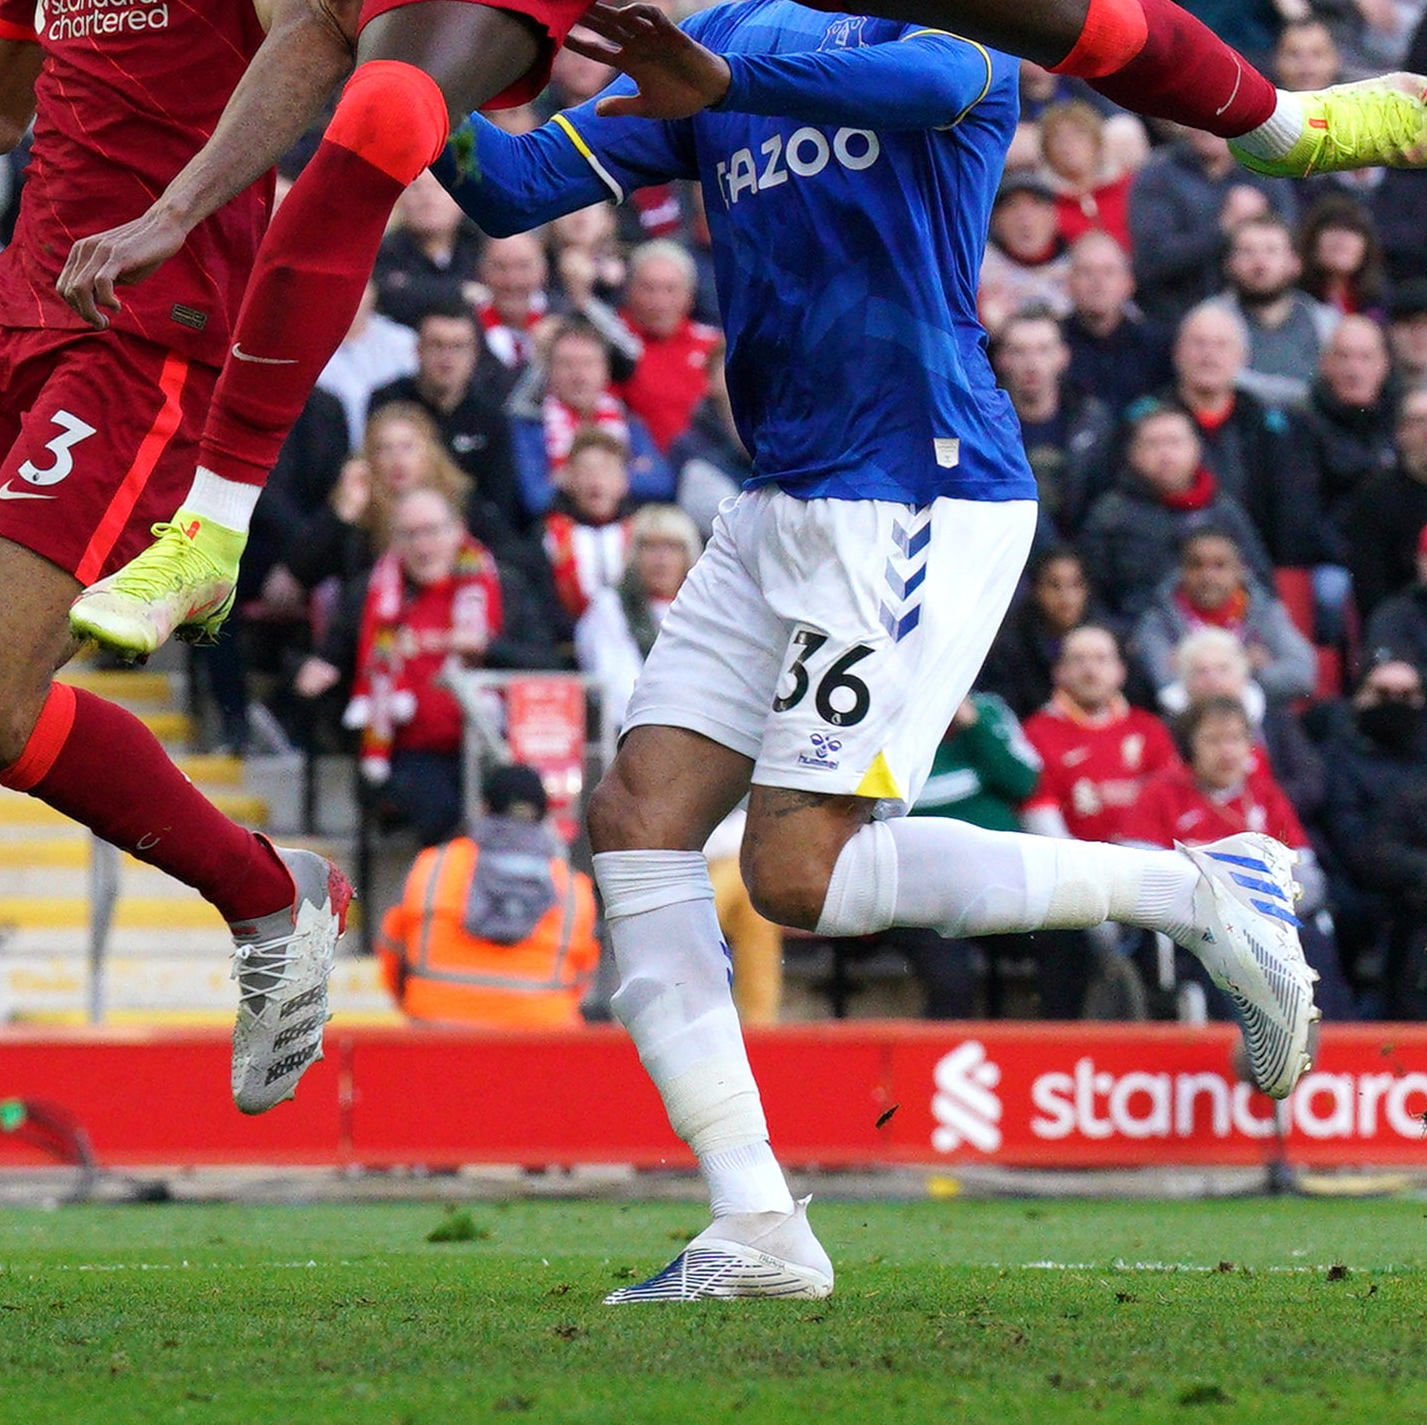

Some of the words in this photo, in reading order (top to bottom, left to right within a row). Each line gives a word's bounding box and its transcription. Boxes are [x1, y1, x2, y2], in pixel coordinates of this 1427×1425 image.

[48, 3, 169, 41] chartered
[18, 409, 98, 486] 3
[772, 629, 876, 727] 36
